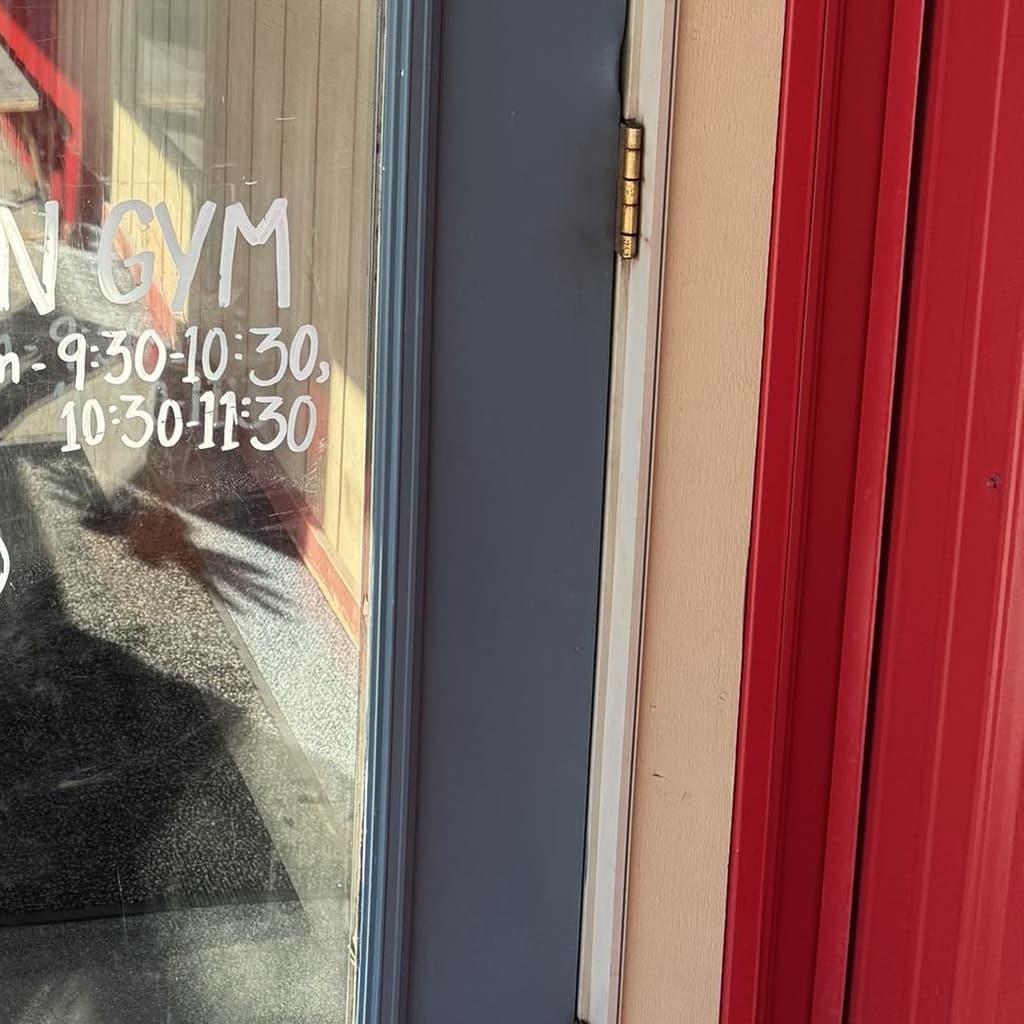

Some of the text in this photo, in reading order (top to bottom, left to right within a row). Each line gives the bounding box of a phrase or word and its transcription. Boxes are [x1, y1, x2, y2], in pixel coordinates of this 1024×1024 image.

[97, 198, 291, 313] GYM
[57, 324, 330, 392] 9:30-10:30,
[60, 390, 317, 452] 10:30-11:30
